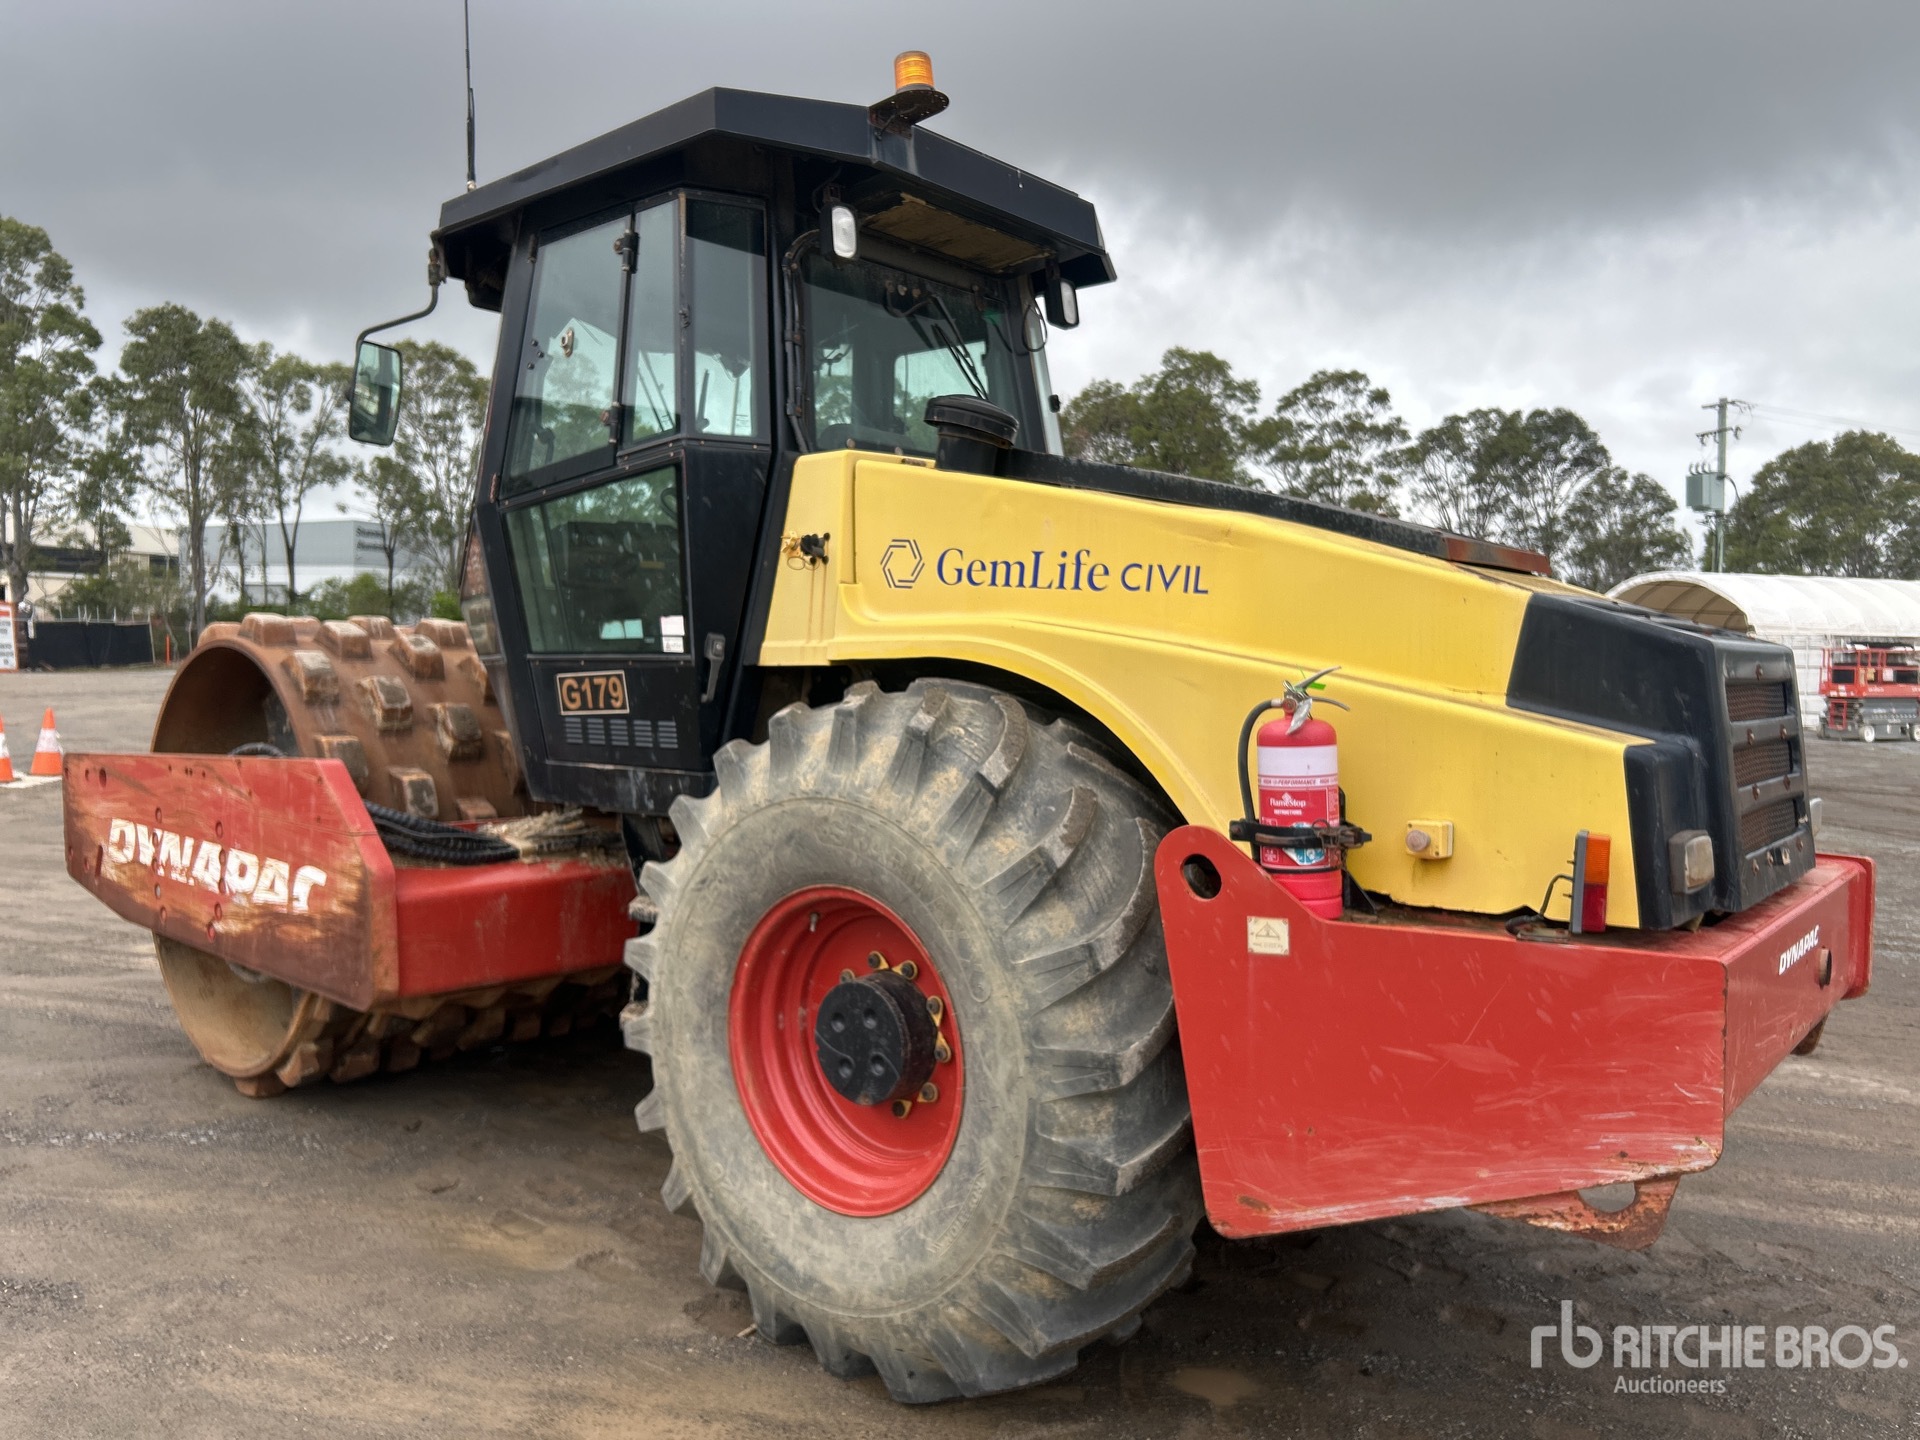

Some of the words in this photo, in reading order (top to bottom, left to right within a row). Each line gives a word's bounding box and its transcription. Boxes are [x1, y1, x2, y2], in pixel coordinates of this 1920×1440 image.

[937, 548, 1110, 592] GemLife
[1121, 563, 1209, 594] CIVIL
[562, 675, 624, 710] G179
[108, 818, 328, 914] DYNAPAC
[1778, 924, 1820, 976] DYNAPAC
